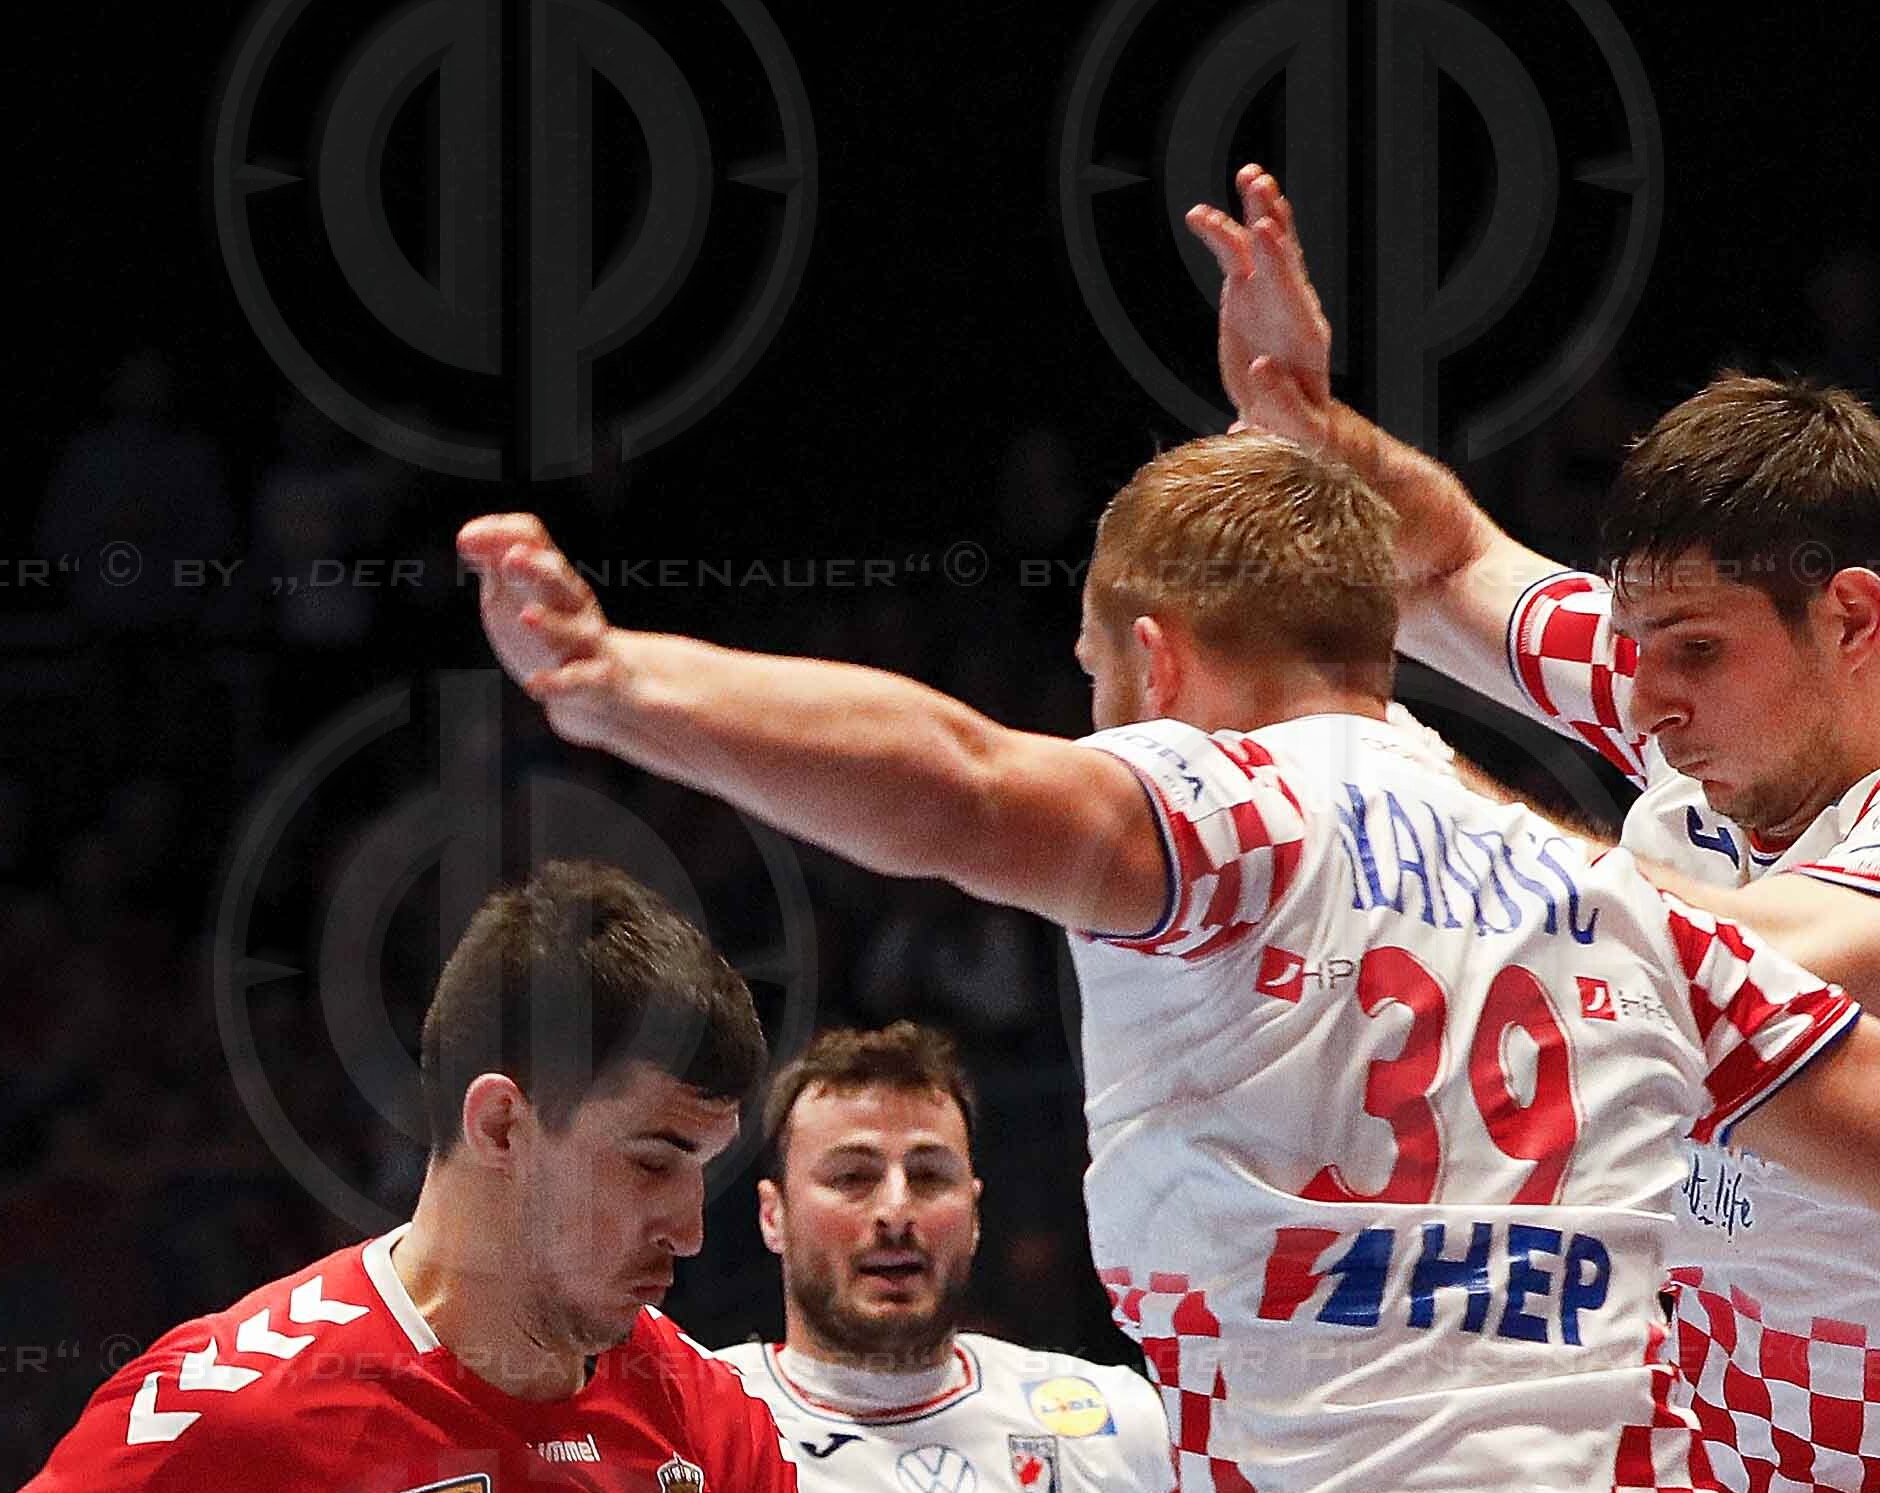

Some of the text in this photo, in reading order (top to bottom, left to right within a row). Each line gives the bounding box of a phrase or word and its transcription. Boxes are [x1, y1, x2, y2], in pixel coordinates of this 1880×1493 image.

[1304, 959, 1354, 989] HP
[1301, 945, 1580, 1205] 39
[1407, 1222, 1611, 1347] HEP
